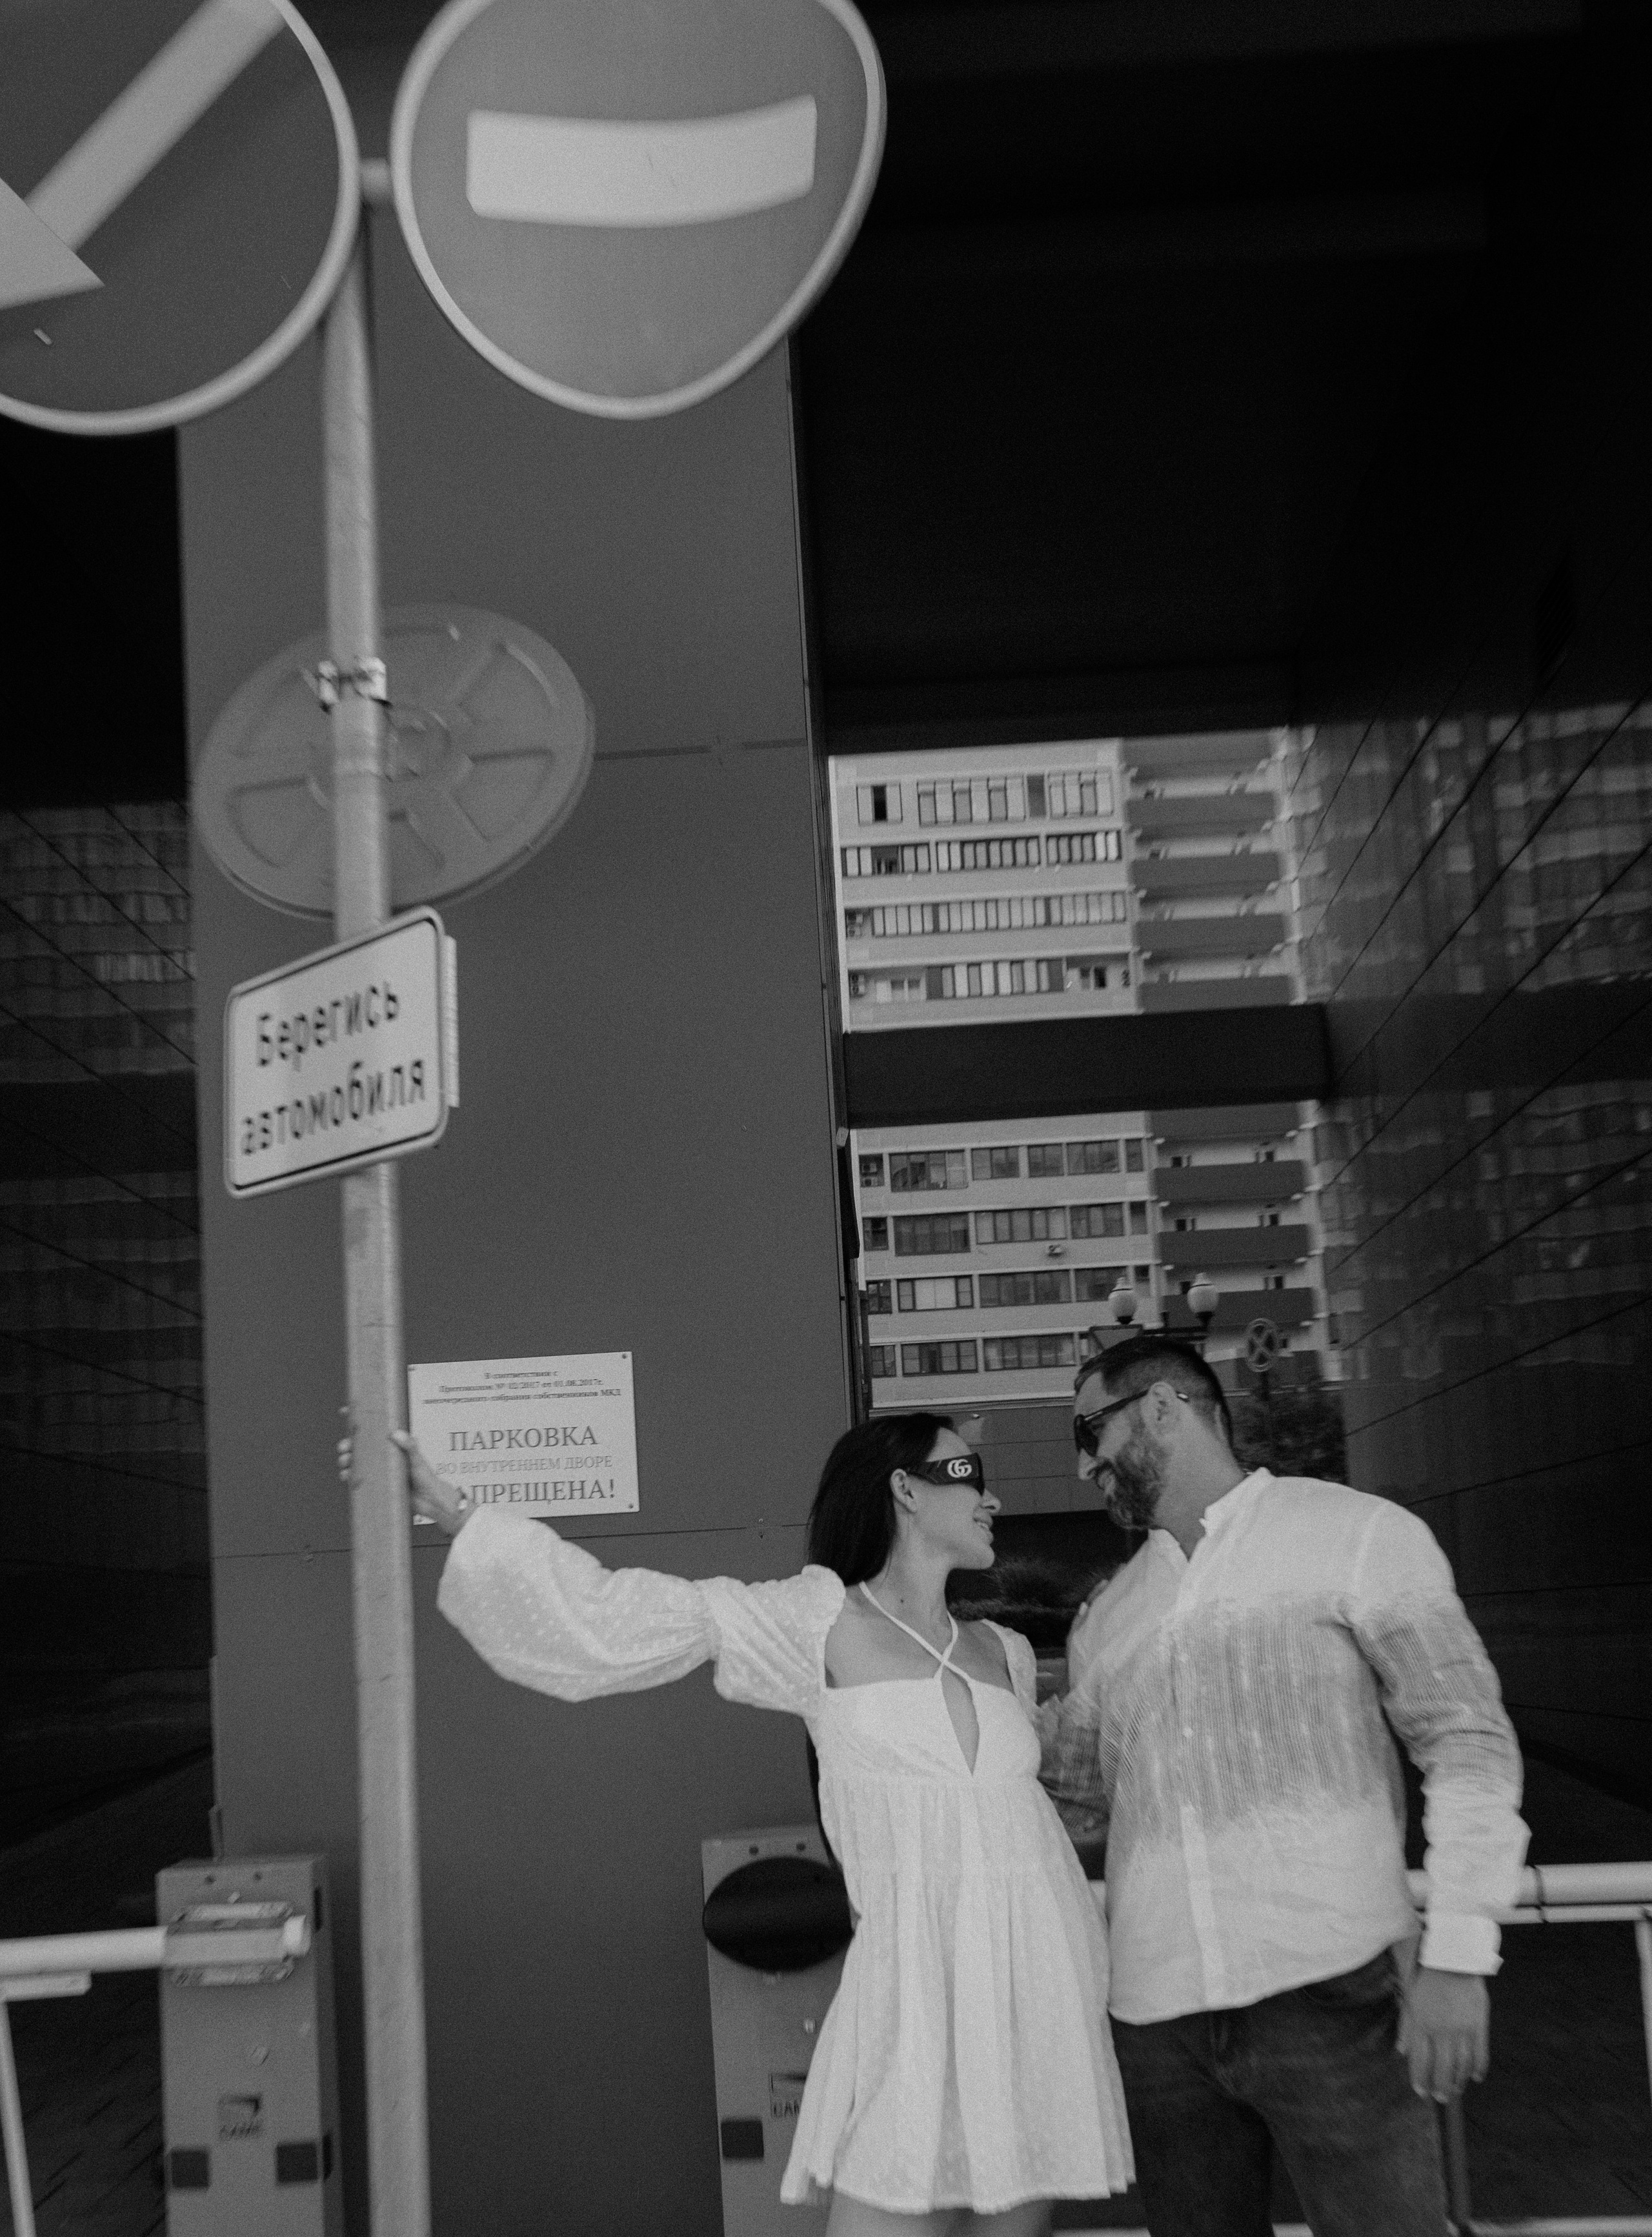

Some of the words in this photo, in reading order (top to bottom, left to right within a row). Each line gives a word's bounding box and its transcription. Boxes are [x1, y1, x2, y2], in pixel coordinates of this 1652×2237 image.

[258, 980, 400, 1071] Берегись
[242, 1060, 426, 1157] автомобиля
[447, 1425, 599, 1452] ПАРКОВКА
[458, 1458, 560, 1474] ВНУТРЕННЕМ
[564, 1455, 614, 1470] ДВОРЕ
[469, 1479, 616, 1504] ПРЕЩЕНА!
